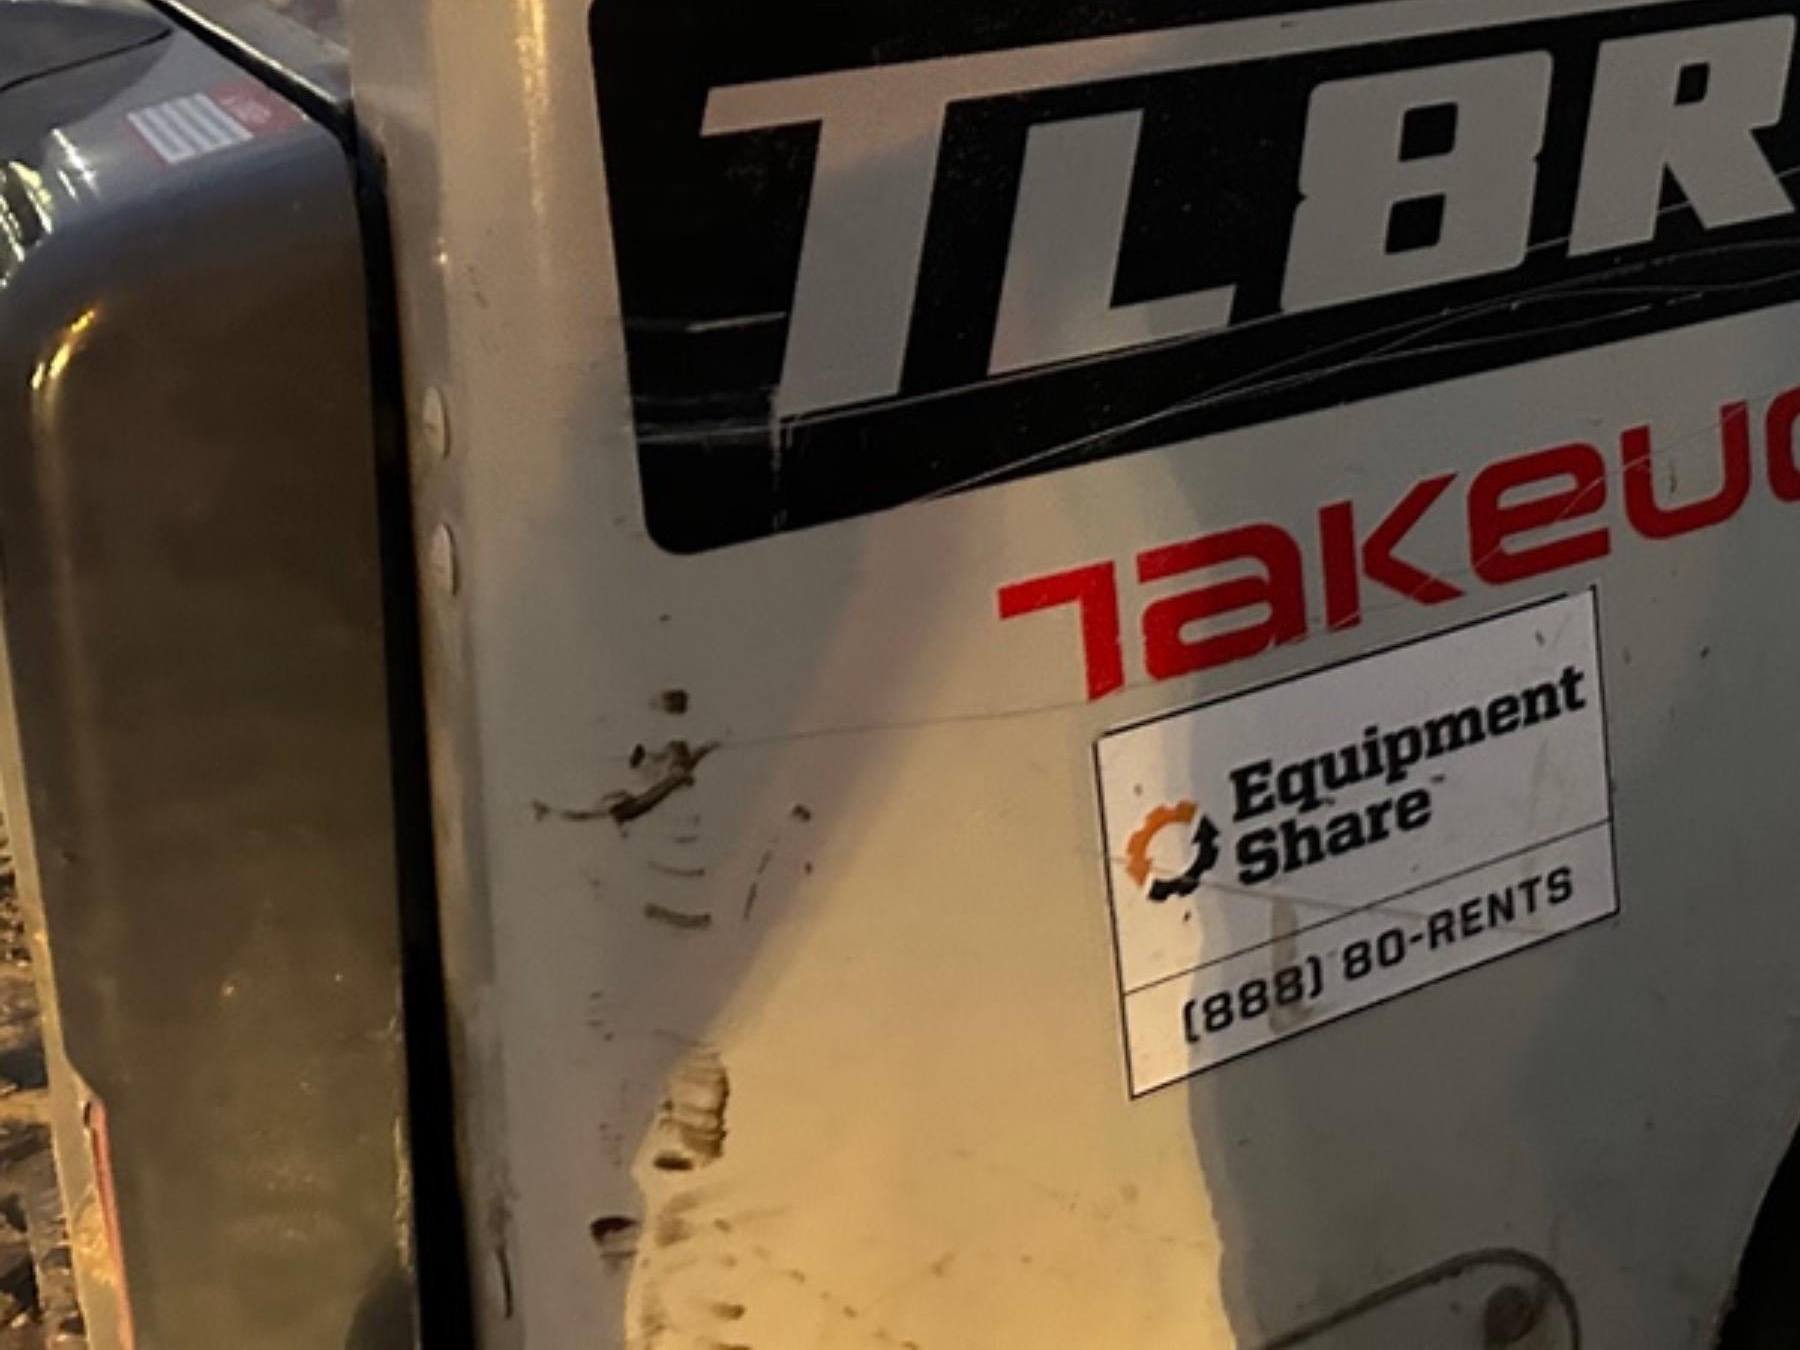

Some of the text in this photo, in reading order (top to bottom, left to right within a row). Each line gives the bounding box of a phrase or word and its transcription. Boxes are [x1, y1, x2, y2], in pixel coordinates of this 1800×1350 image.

[1229, 665, 1587, 822] Equipment
[1182, 865, 1575, 1045] (888) 80-RENTS
